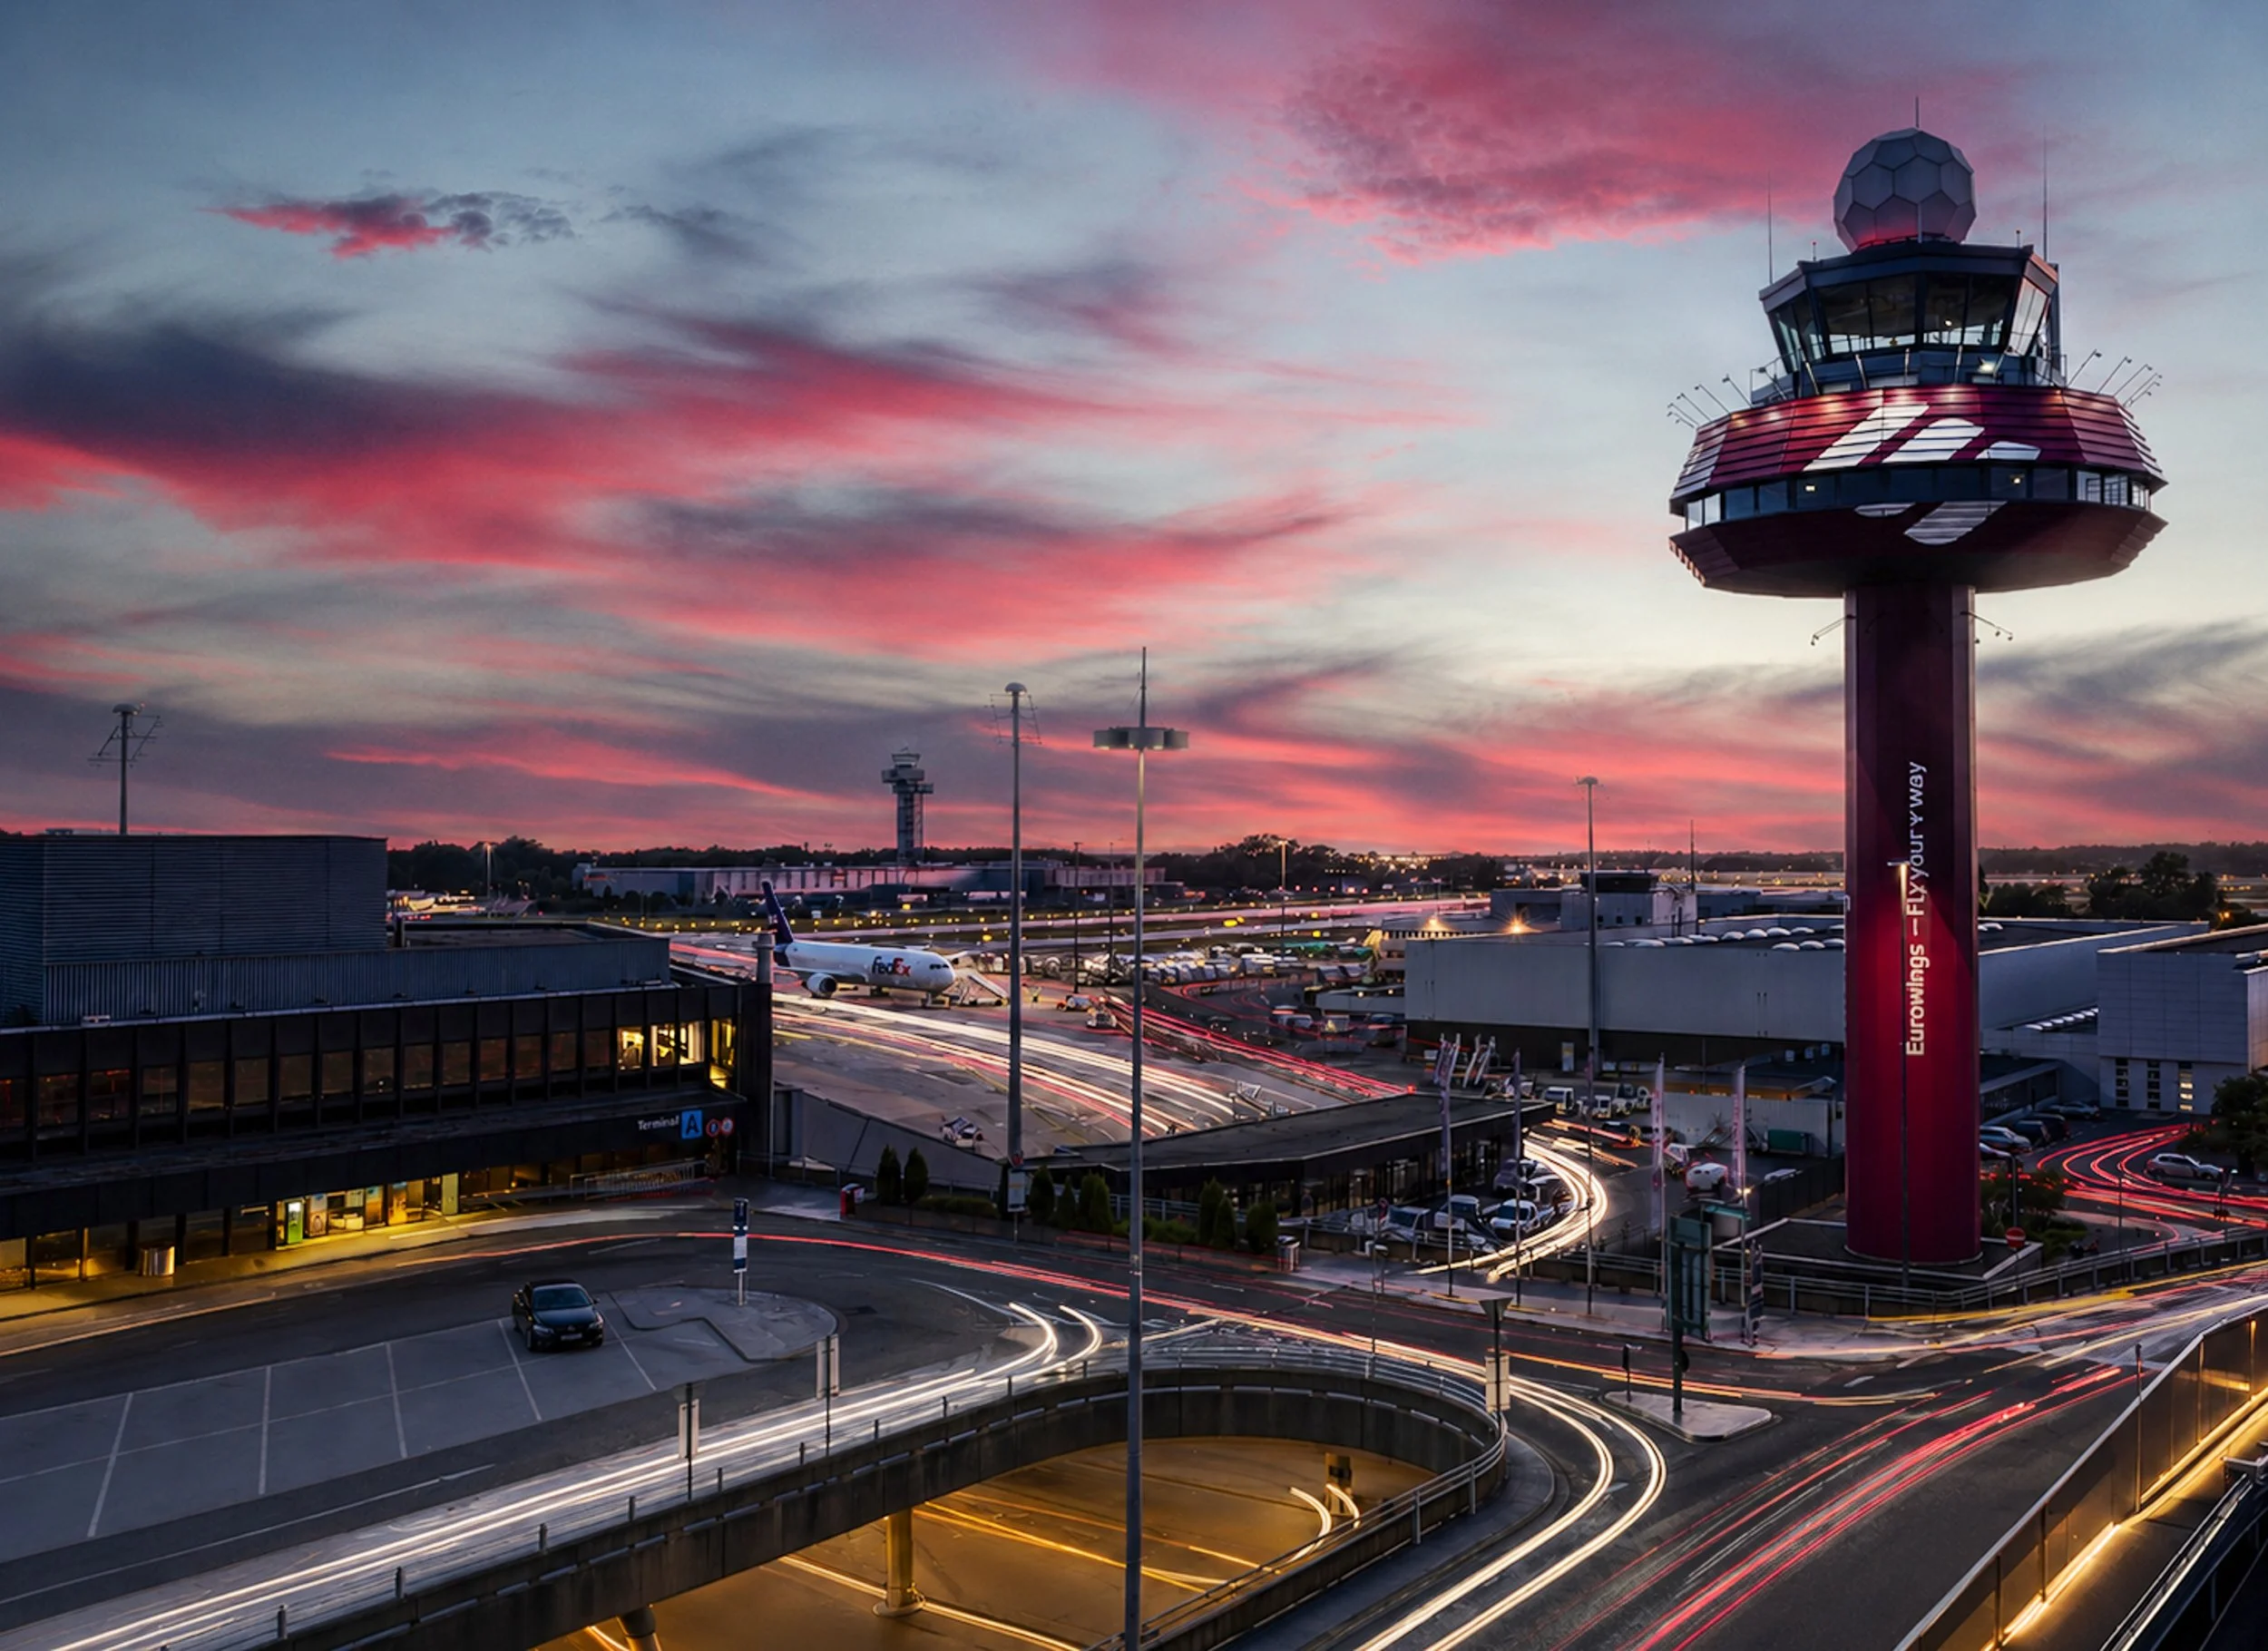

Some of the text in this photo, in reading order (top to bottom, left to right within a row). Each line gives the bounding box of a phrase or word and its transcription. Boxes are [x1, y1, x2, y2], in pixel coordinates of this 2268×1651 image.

[1909, 761, 1928, 808] way
[1906, 881, 1928, 916] Fly
[1906, 944, 1930, 1056] Eurowings
[638, 1113, 700, 1135] Terminal A
